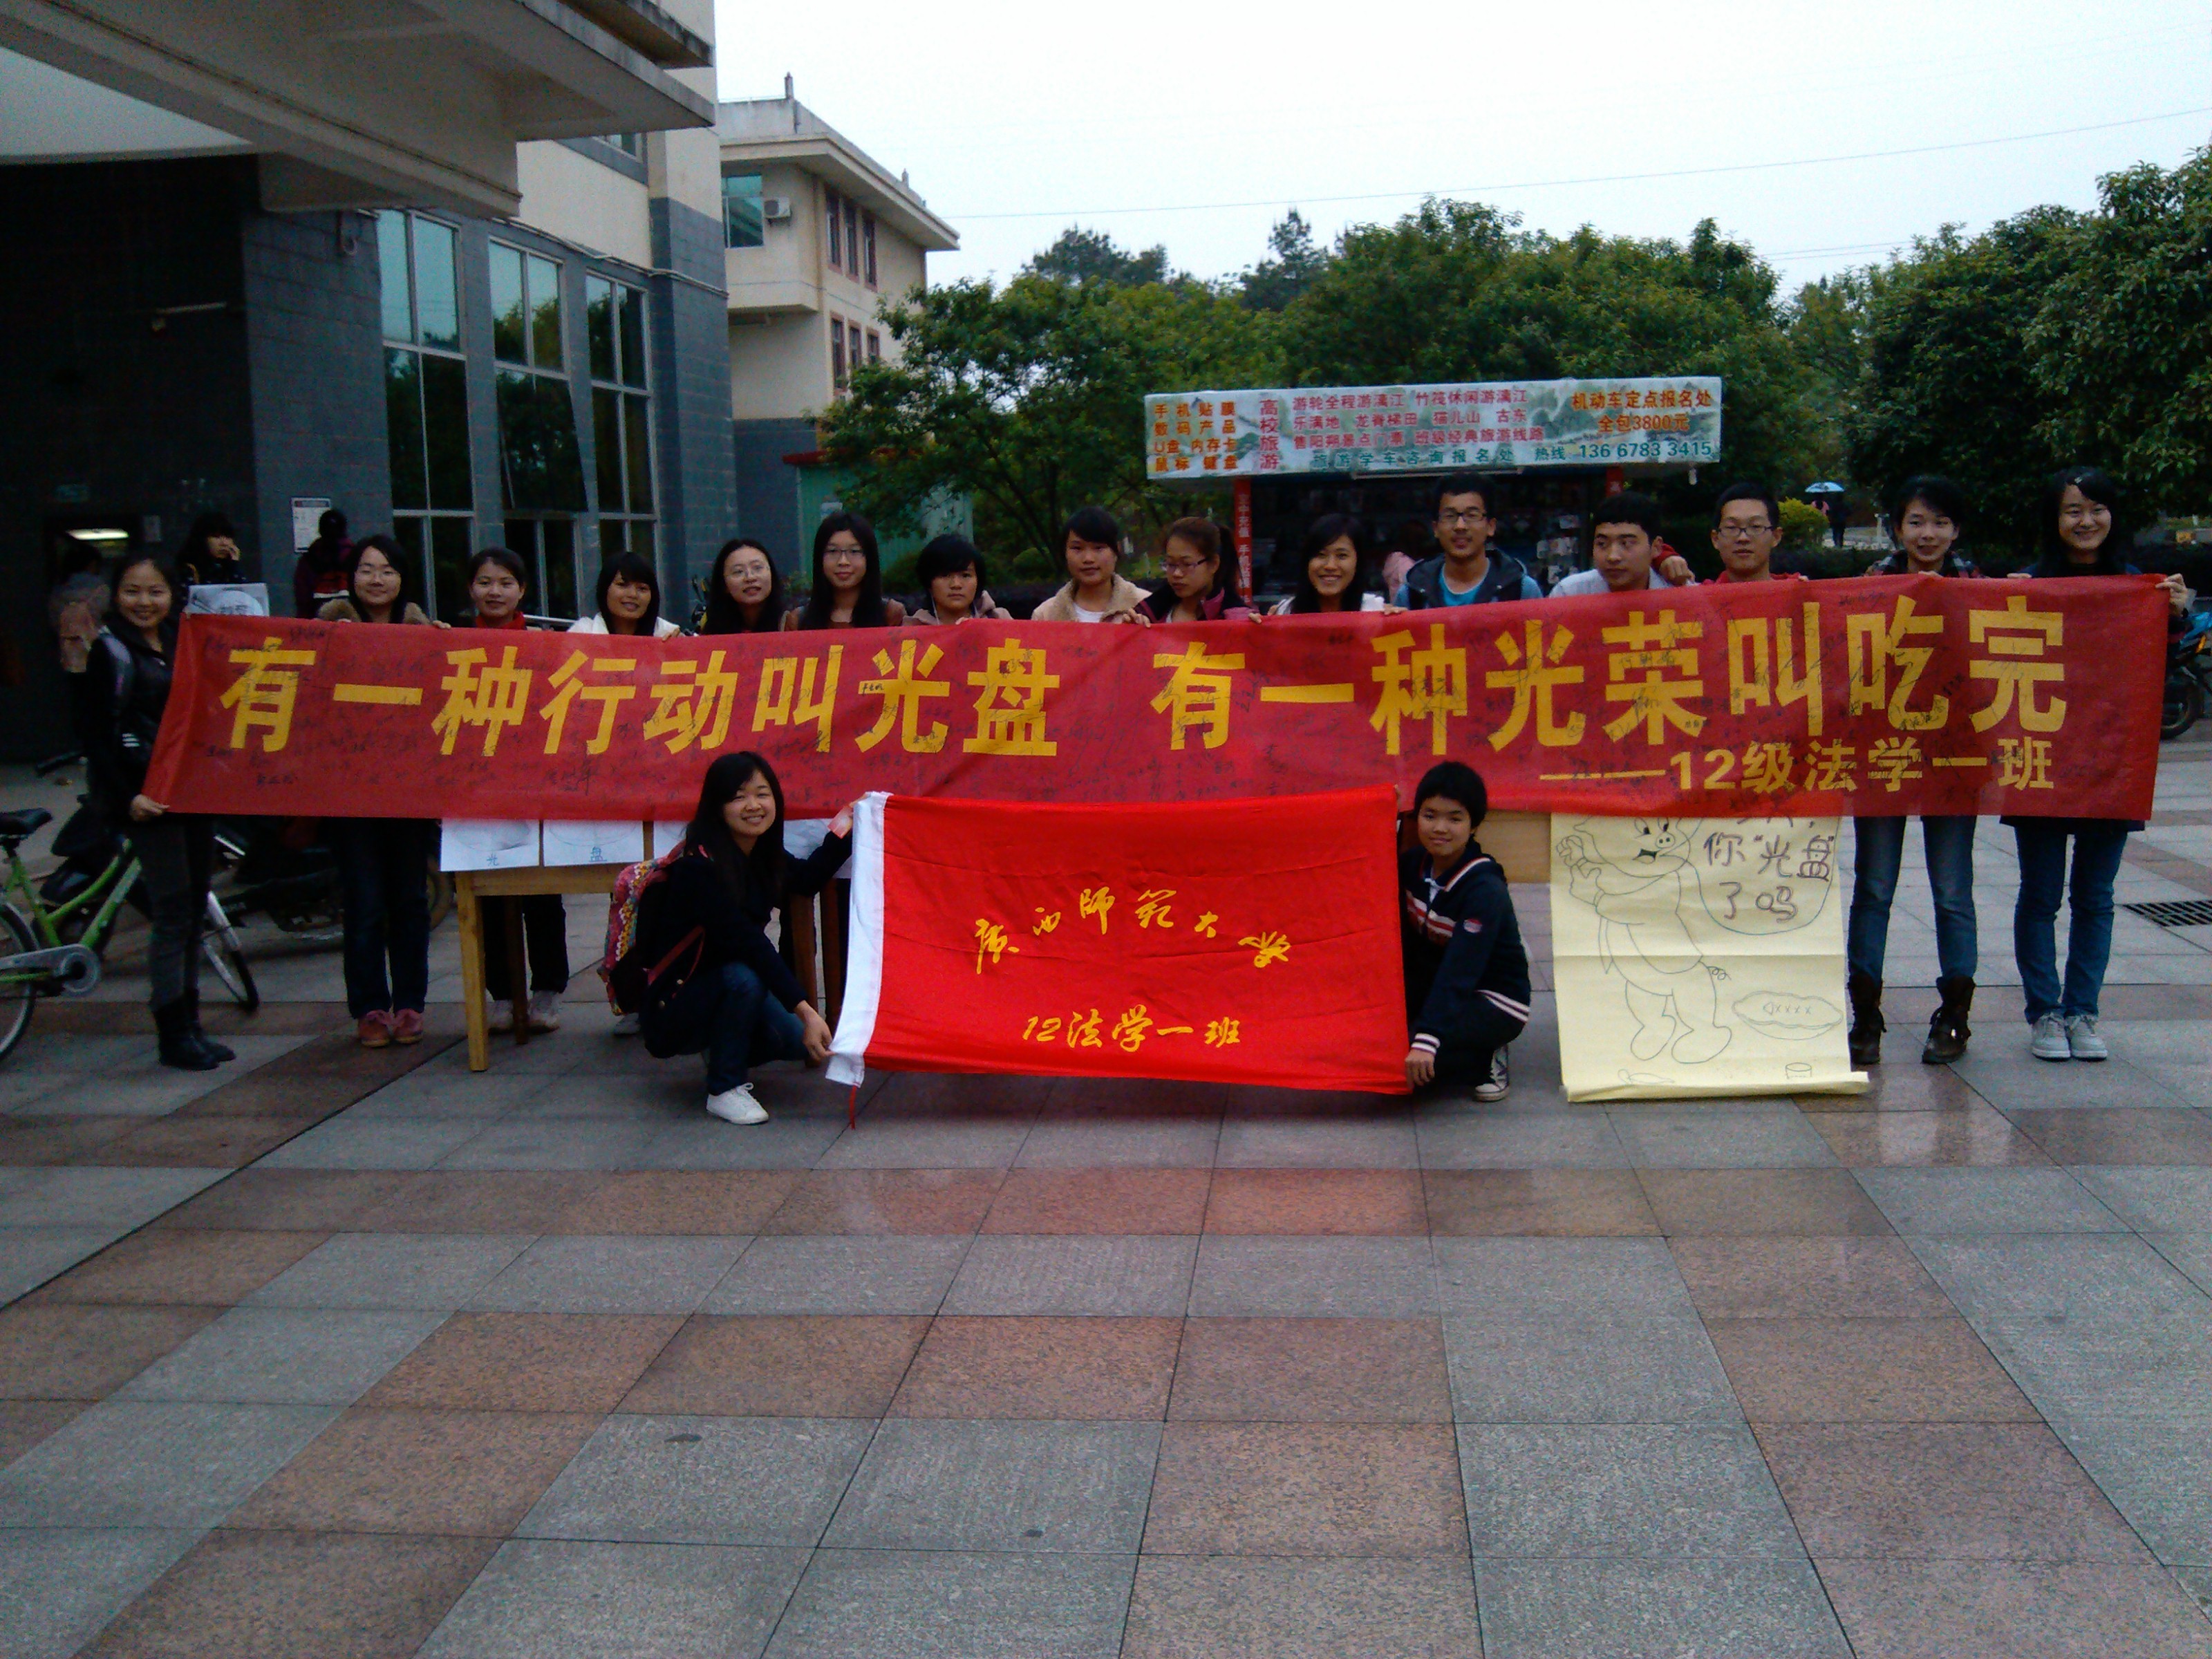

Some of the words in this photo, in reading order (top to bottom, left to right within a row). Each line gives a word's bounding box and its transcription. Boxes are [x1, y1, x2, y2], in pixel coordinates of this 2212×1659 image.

[1154, 401, 1236, 418] 手机贴膜
[1293, 393, 1405, 411] 游轮全程游漓江
[1415, 389, 1528, 406] 竹筏休闲游漓江
[1573, 389, 1712, 410] 机动车定点报名处
[1154, 419, 1236, 436] 数码产品
[1294, 415, 1340, 430] 乐满地
[1496, 408, 1527, 422] 古东
[1598, 413, 1690, 433] 全包3800元
[1259, 399, 1280, 469] 高校旅游
[1294, 431, 1405, 449] 售阳朔景点门票
[1415, 426, 1544, 444] 班级经典旅游线路
[1154, 439, 1181, 453] U盘
[1191, 438, 1238, 453] 内存卡
[1535, 446, 1566, 461] 热线
[1580, 444, 1611, 458] 136
[1618, 442, 1661, 457] 6783
[1667, 441, 1712, 456] 3415
[1156, 457, 1190, 472] 鼠标
[1203, 454, 1239, 470] 键盘
[220, 635, 1061, 756] 有一种行动叫光盘
[1150, 595, 2067, 756] 有一种光荣叫吃完
[1719, 881, 1797, 924] 了吗
[1022, 1004, 1241, 1053] 12法学一班
